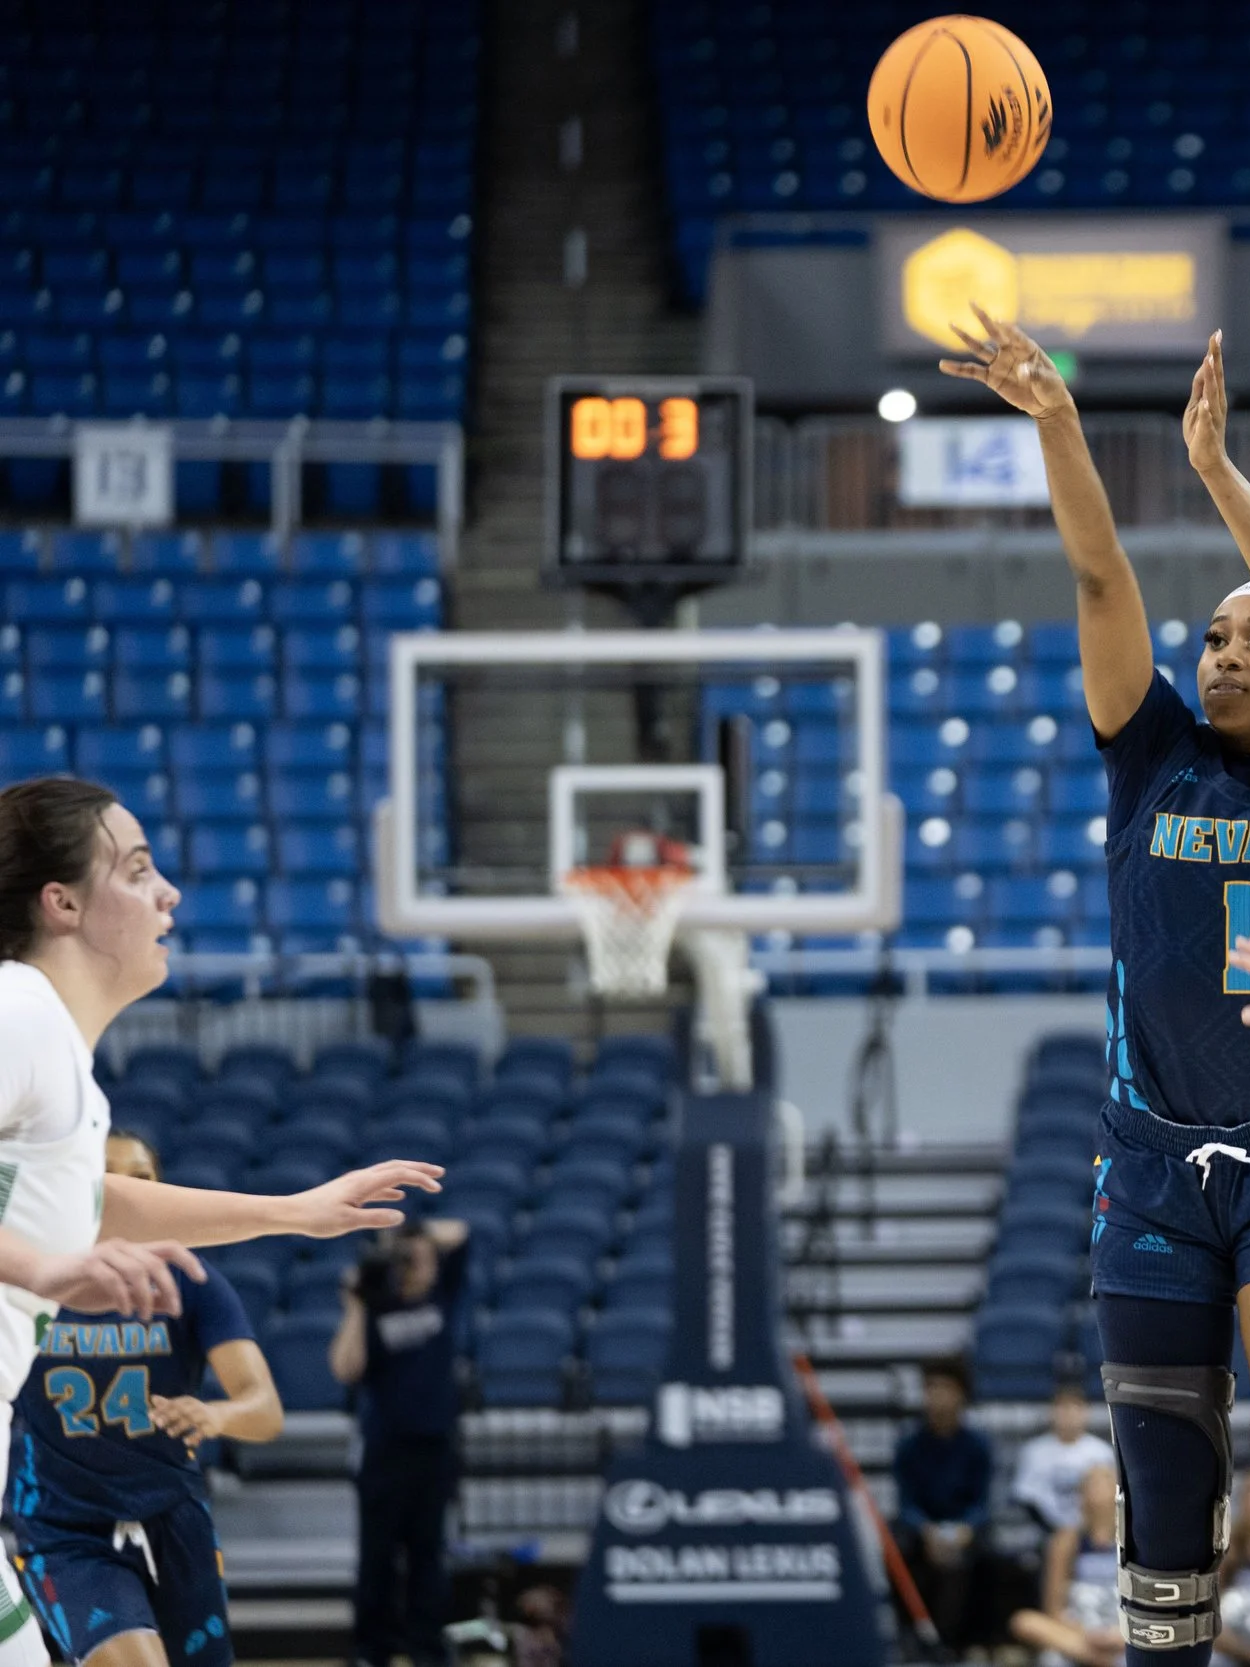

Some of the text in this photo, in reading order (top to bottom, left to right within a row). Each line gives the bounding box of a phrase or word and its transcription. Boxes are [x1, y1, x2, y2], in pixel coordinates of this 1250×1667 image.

[1133, 1241, 1173, 1254] adidas
[44, 1364, 155, 1438] 24
[667, 1489, 841, 1527] LEXUS
[733, 1545, 841, 1582] LEXUS
